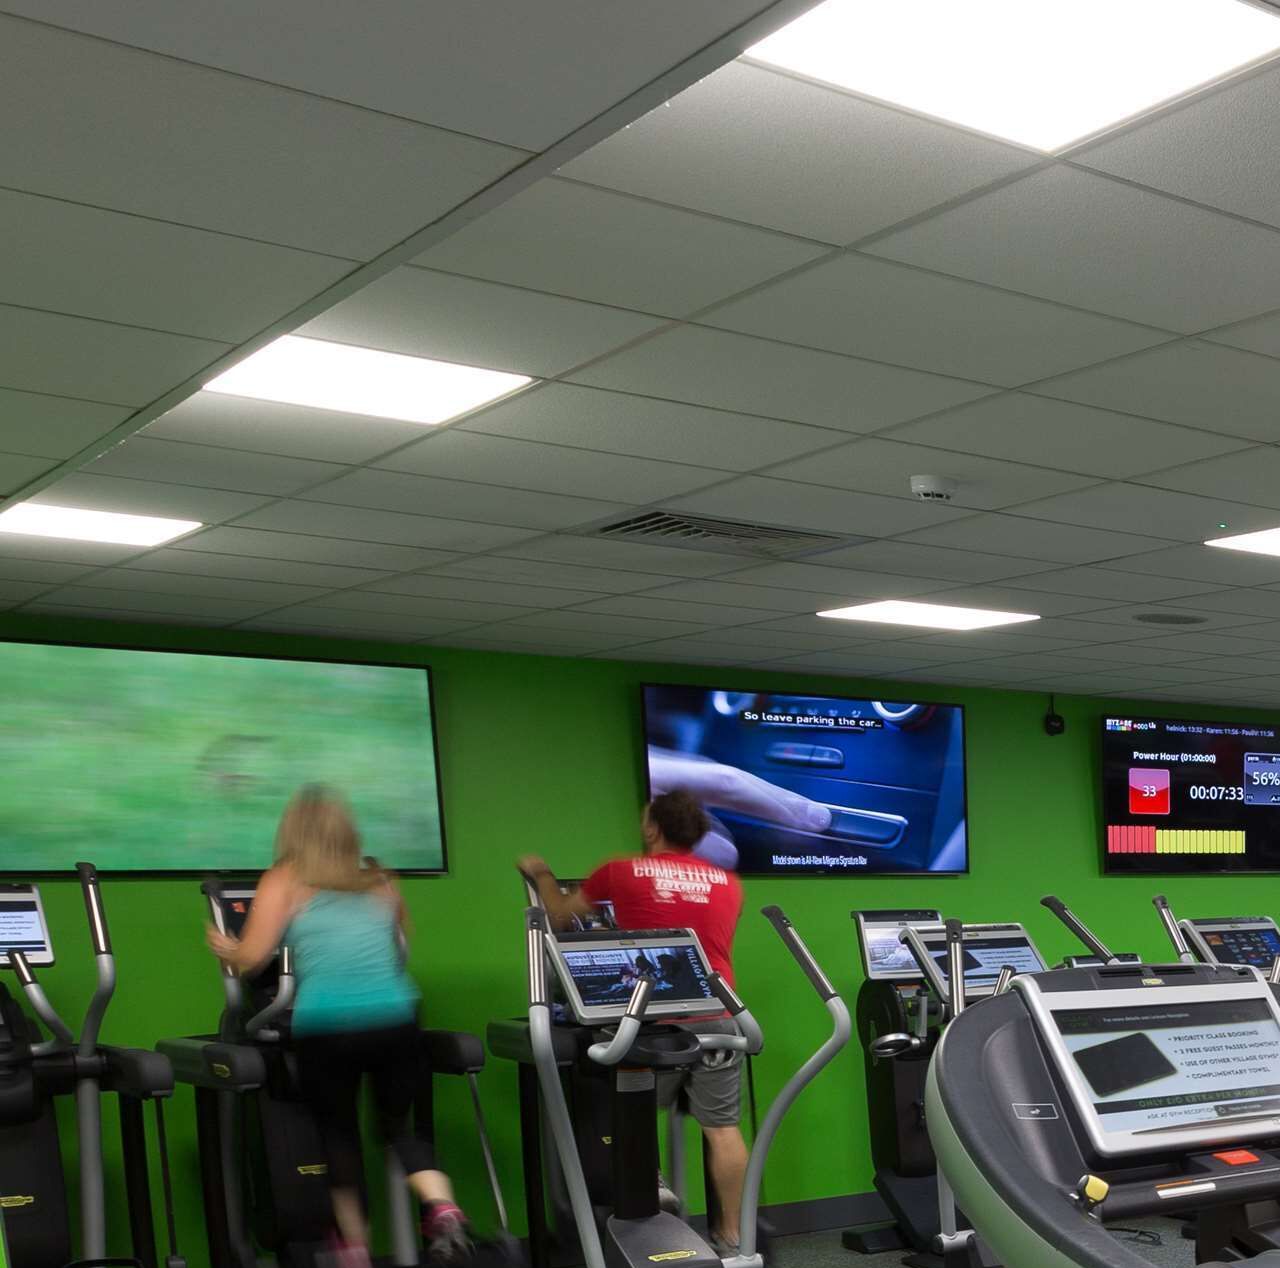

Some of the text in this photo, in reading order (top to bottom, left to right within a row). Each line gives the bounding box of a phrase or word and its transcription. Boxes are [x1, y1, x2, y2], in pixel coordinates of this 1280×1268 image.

[744, 711, 759, 720] So
[762, 712, 793, 722] leave
[796, 715, 834, 726] parking
[838, 717, 856, 726] the
[1133, 751, 1216, 764] Power Hour (01:00:00)
[1252, 771, 1280, 786] 56%
[1142, 785, 1157, 797] 33
[1189, 786, 1244, 800] 00:07:33
[633, 862, 728, 886] COMPETITOR
[685, 947, 705, 979] VILLAGE
[1173, 1030, 1259, 1042] PRIORITY CLASS BOOKING
[1186, 1046, 1201, 1054] FREE
[1203, 1045, 1224, 1053] GUEST
[1225, 1043, 1248, 1051] PASSES
[1249, 1041, 1280, 1049] MONTHLY
[1185, 1059, 1197, 1067] USE
[1209, 1057, 1231, 1065] OTHER
[1232, 1054, 1258, 1063] VILLAGE
[1191, 1067, 1271, 1079] COMPLIMENTARY TOWEL
[1139, 1098, 1162, 1108] ONLY
